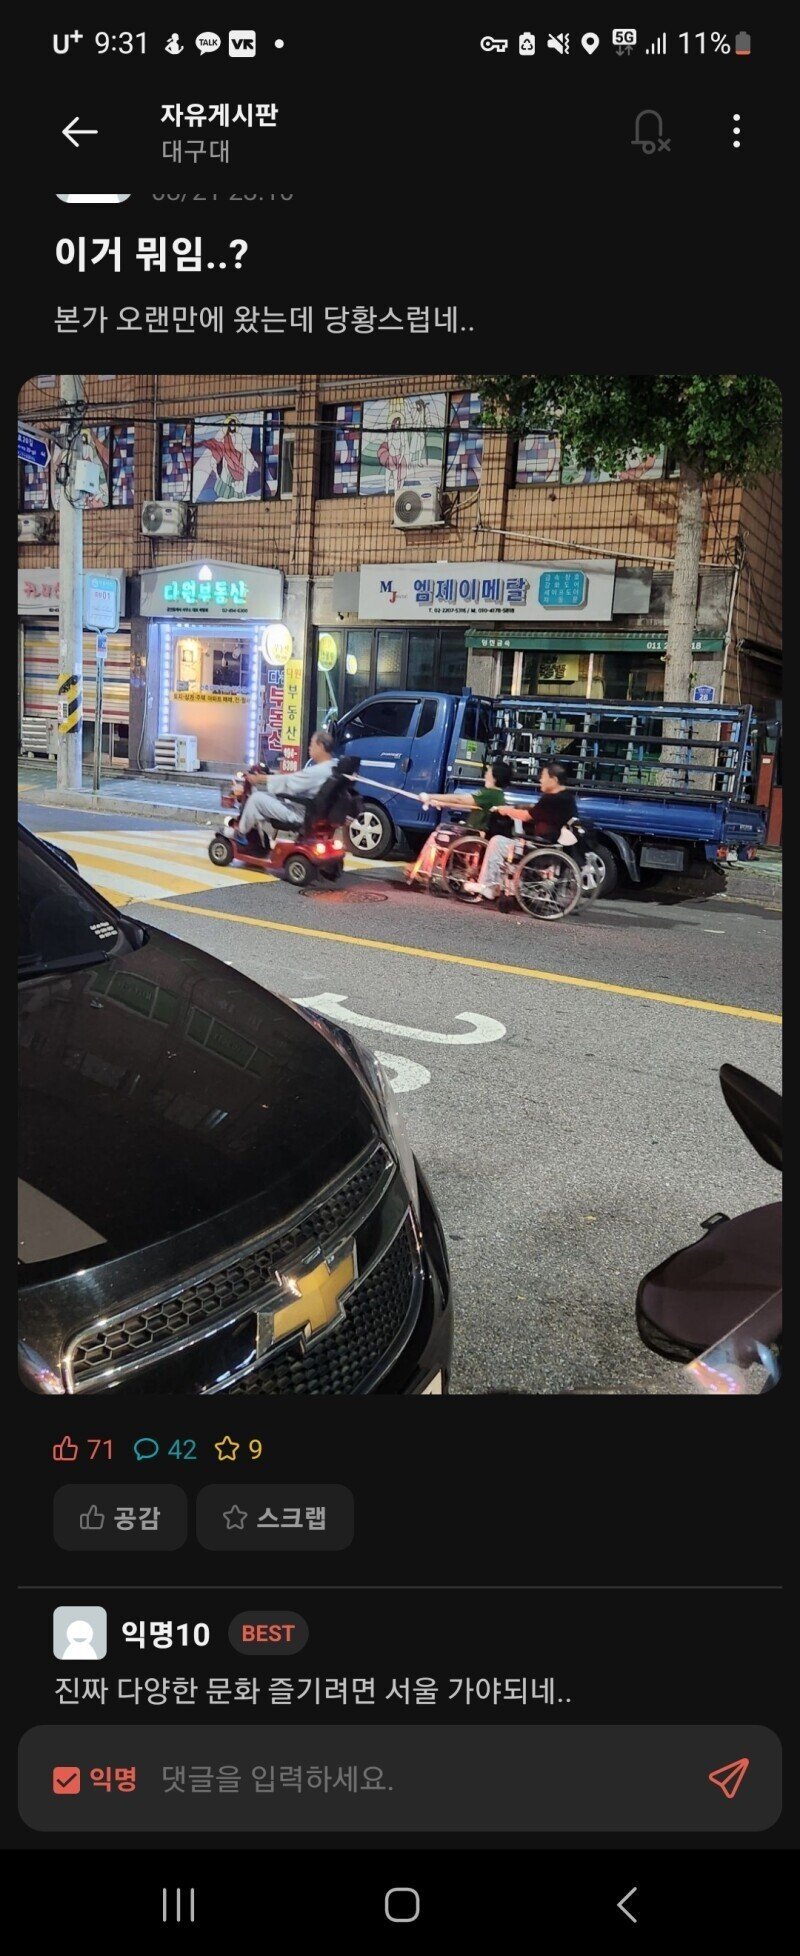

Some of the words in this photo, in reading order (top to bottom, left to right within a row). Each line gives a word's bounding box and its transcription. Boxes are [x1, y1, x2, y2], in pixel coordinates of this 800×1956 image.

[52, 29, 84, 54] U+
[94, 30, 146, 55] 9:31
[199, 38, 218, 46] TALK
[231, 39, 254, 50] VR
[615, 31, 634, 43] 5G
[678, 31, 732, 55] 11%
[160, 103, 279, 128] 자유게시판
[162, 139, 230, 164] 대구대
[55, 236, 122, 272] 이거
[135, 236, 249, 272] 뭐임..?
[54, 306, 108, 334] 본가
[116, 306, 224, 334] 오랜만에
[233, 306, 313, 334] 왔는데
[324, 306, 475, 334] 당황스럽네..
[164, 579, 250, 605] 다원부동산
[414, 578, 528, 604] 엠제이메탈
[646, 641, 661, 650] 011
[286, 684, 298, 741] 부동산
[86, 1438, 113, 1460] 71
[167, 1438, 198, 1460] 42
[248, 1438, 264, 1460] 9
[113, 1506, 161, 1532] 공감
[256, 1506, 326, 1531] 스크랩
[121, 1620, 211, 1650] 익명10
[241, 1624, 296, 1646] BEST
[54, 1677, 109, 1705] 진짜
[117, 1677, 198, 1705] 다양한
[205, 1677, 261, 1705] 문화
[268, 1677, 376, 1705] 즐기려면
[384, 1677, 439, 1705] 서울
[447, 1677, 572, 1705] 가야되네..
[89, 1765, 137, 1793] 익명
[162, 1765, 242, 1794] 댓글을
[251, 1765, 393, 1794] 입력하세요.
